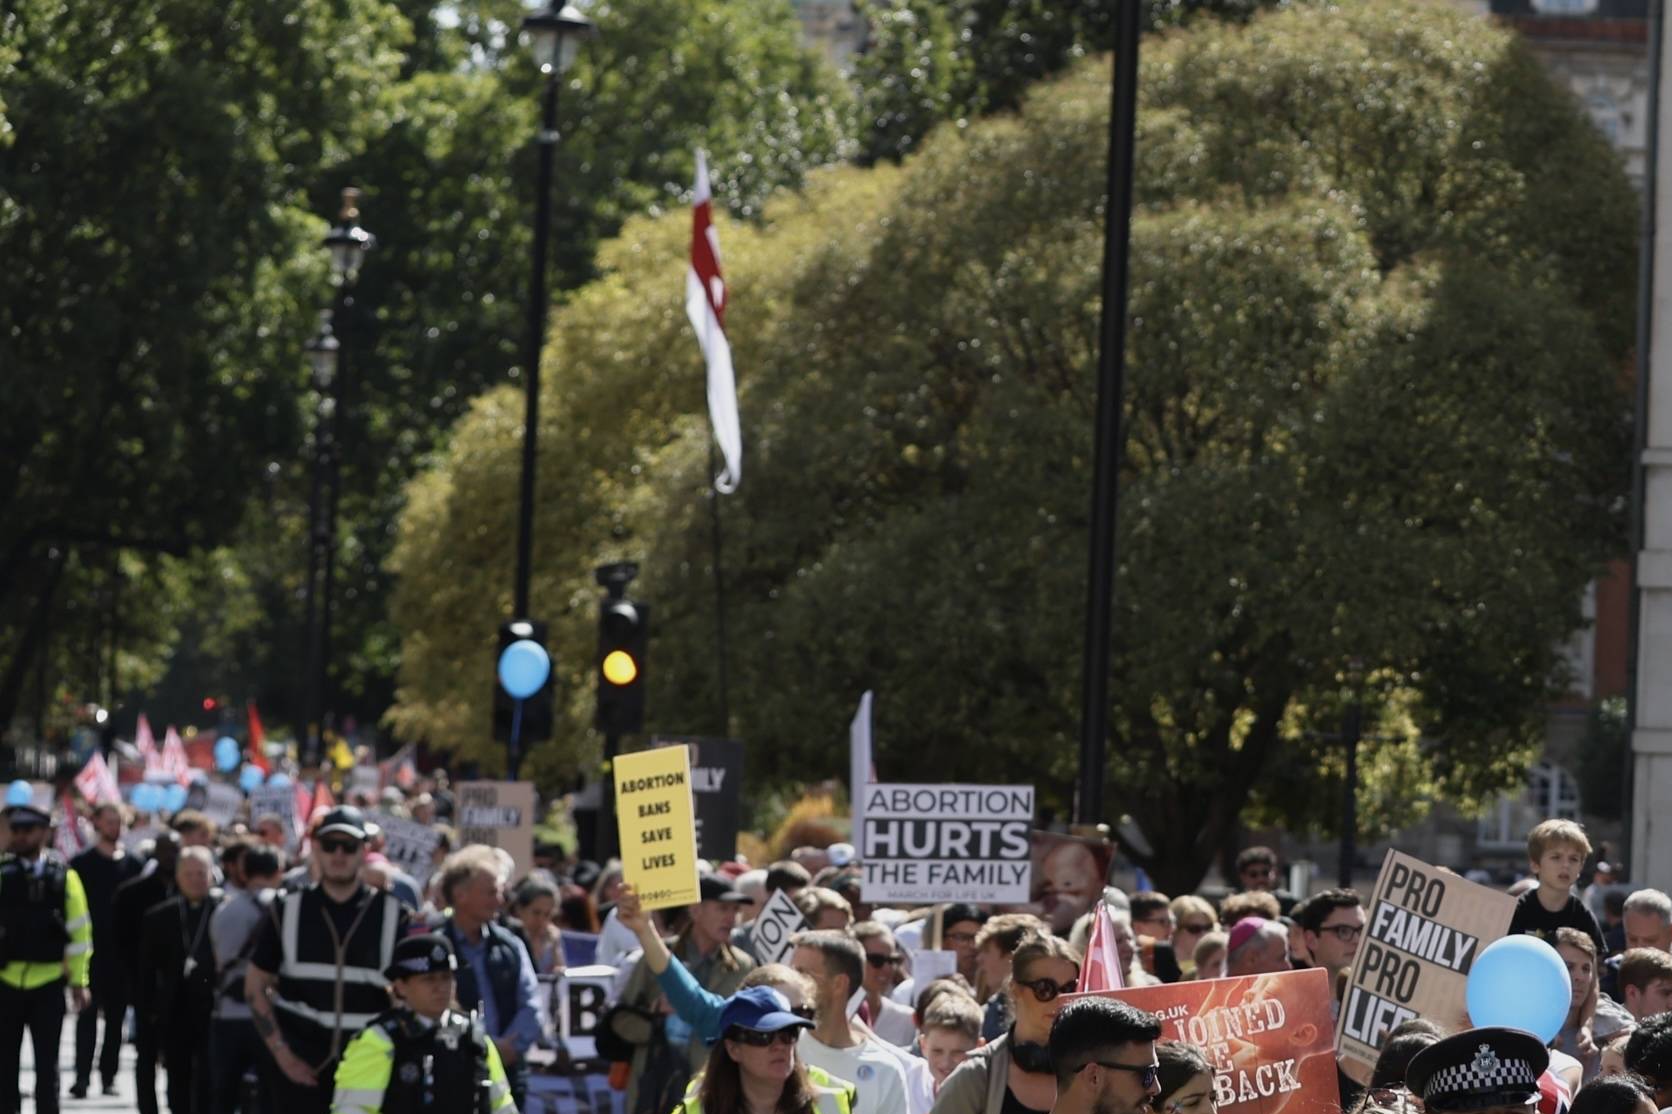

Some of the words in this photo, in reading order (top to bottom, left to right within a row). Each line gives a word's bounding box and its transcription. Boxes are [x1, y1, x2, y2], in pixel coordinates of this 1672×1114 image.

[620, 771, 685, 795] ABORTION
[638, 801, 671, 818] BANS
[867, 789, 1031, 813] ABORTION
[641, 827, 673, 844] SAVE
[865, 820, 1029, 858] HURTS
[642, 853, 676, 871] LIVES
[865, 863, 917, 884] THE
[928, 864, 1027, 886] FAMILY
[1385, 862, 1446, 918] PRO
[1371, 901, 1476, 971] FAMILY
[1358, 942, 1421, 1003] PRO
[1150, 1004, 1189, 1021] G.UK
[1173, 998, 1286, 1045] JOINED
[1213, 1059, 1302, 1107] BACK
